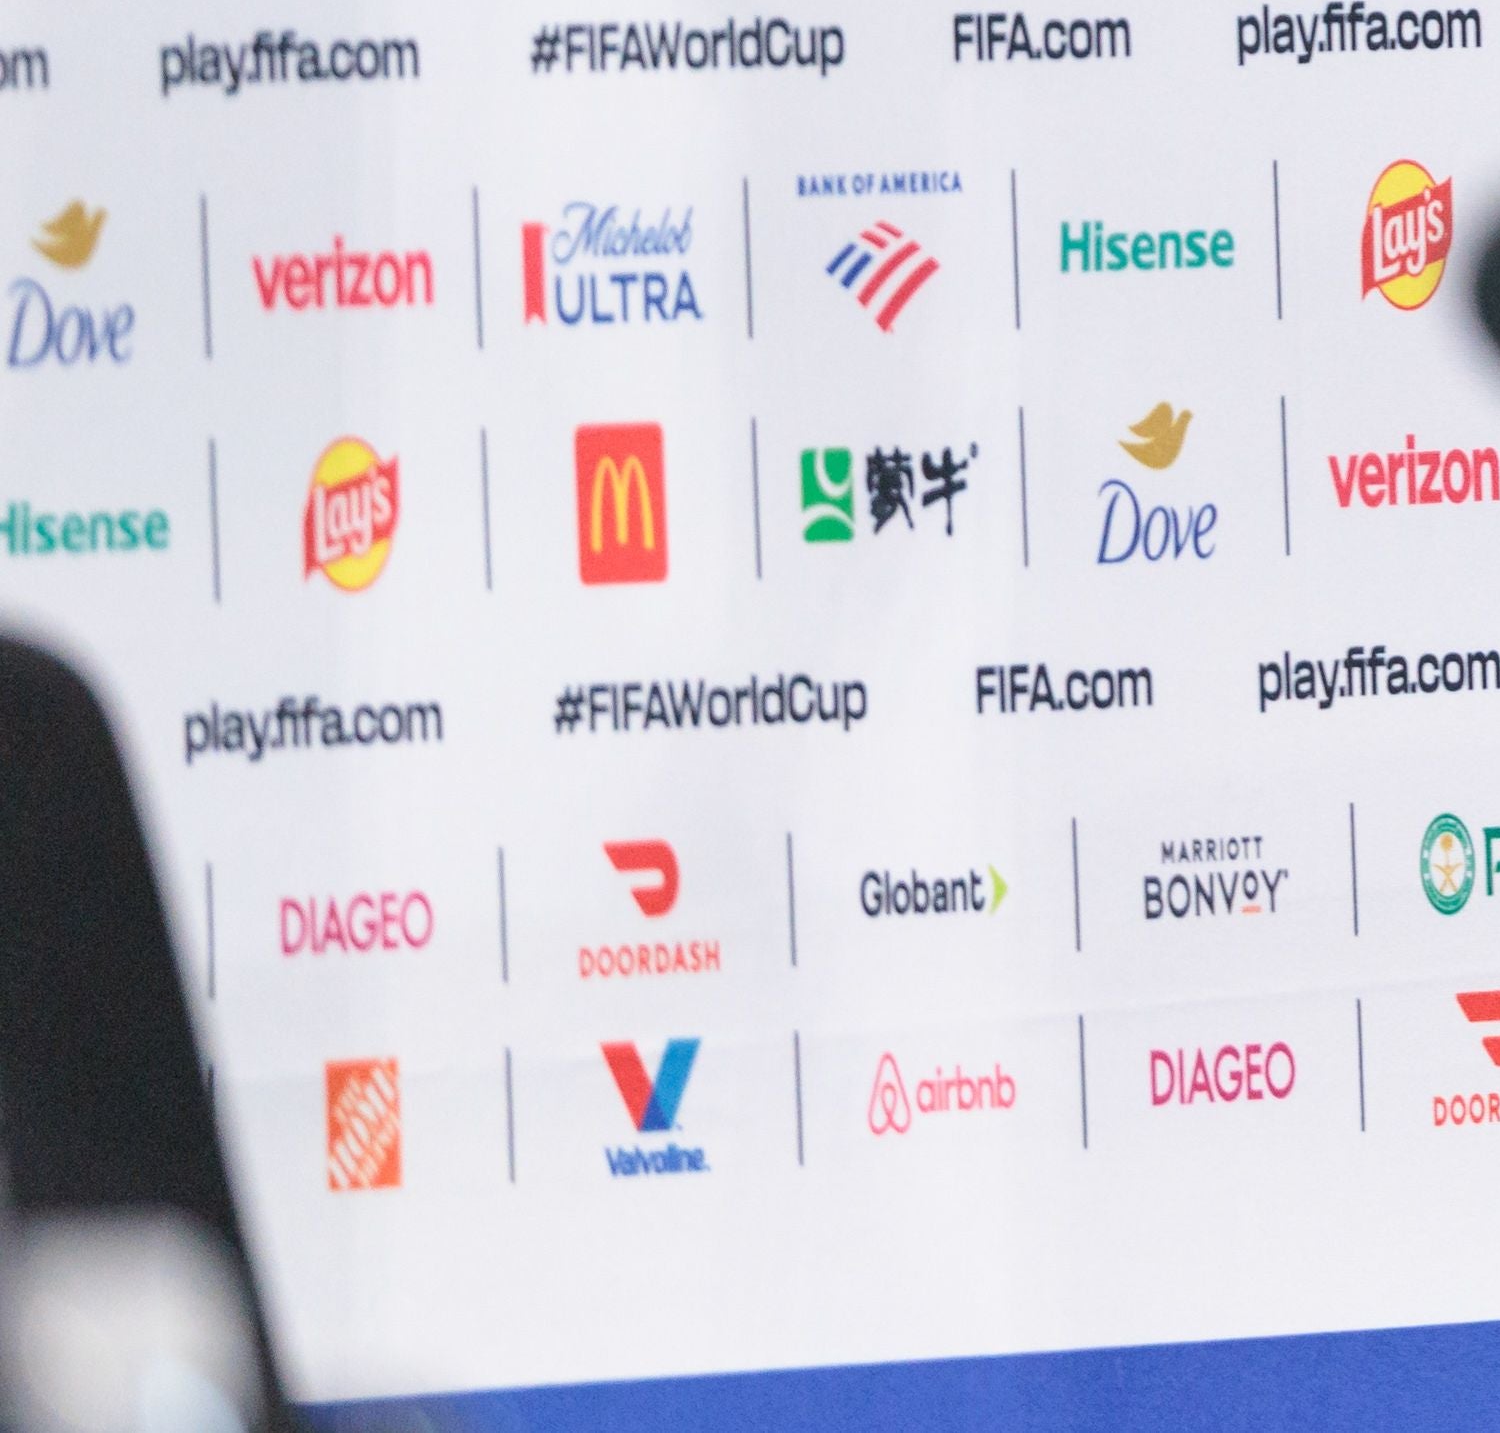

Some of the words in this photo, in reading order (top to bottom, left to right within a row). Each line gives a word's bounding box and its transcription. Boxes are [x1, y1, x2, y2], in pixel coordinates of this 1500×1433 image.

[160, 31, 419, 96] play.fifa.com
[531, 17, 845, 77] #FIFAWorldCup
[953, 13, 1131, 62] FIFA.com
[1237, 1, 1481, 66] play.fifa.com
[798, 176, 846, 196] BANK
[852, 174, 874, 195] OF
[880, 172, 961, 193] AMERICA
[553, 202, 692, 264] Michelob
[1061, 221, 1234, 272] Hisense
[1373, 188, 1445, 282] Lay's
[252, 236, 433, 311] verizon
[555, 271, 702, 326] ULTRA
[7, 279, 135, 368] Dove
[1328, 434, 1500, 508] verizon
[313, 467, 392, 563] Lay's
[1097, 479, 1217, 564] Dove
[554, 674, 867, 732] #FIFAWorldCup
[976, 664, 1152, 714] FIFA.com
[1259, 646, 1500, 713] play.fifa.com
[185, 696, 442, 764] play.fifa.com
[1162, 836, 1262, 862] MARRIOTT
[280, 891, 433, 957] DIAGEO
[860, 871, 985, 917] Globant
[1144, 870, 1288, 919] BONVOY
[579, 941, 720, 978] DOORDASH
[916, 1064, 1016, 1118] airbnb
[1150, 1042, 1295, 1106] DIAGEO
